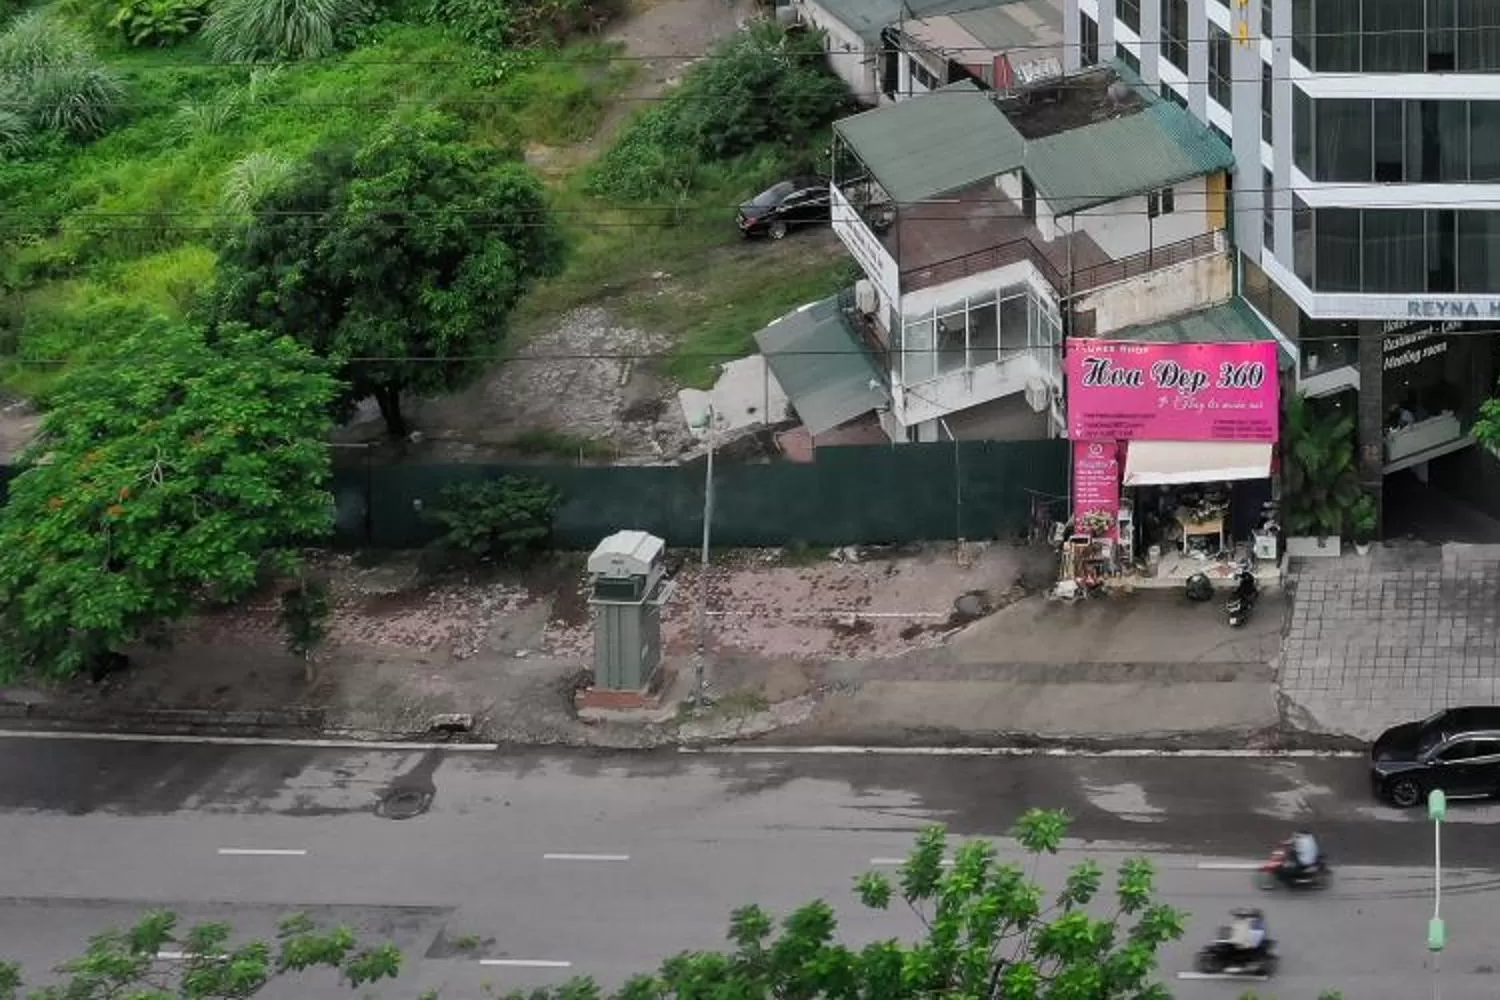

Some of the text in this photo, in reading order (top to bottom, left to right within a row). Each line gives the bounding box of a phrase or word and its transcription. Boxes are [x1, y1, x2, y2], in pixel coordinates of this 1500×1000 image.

[1407, 301, 1479, 317] REYNA
[1082, 356, 1264, 395] Hoa Đẹp 360
